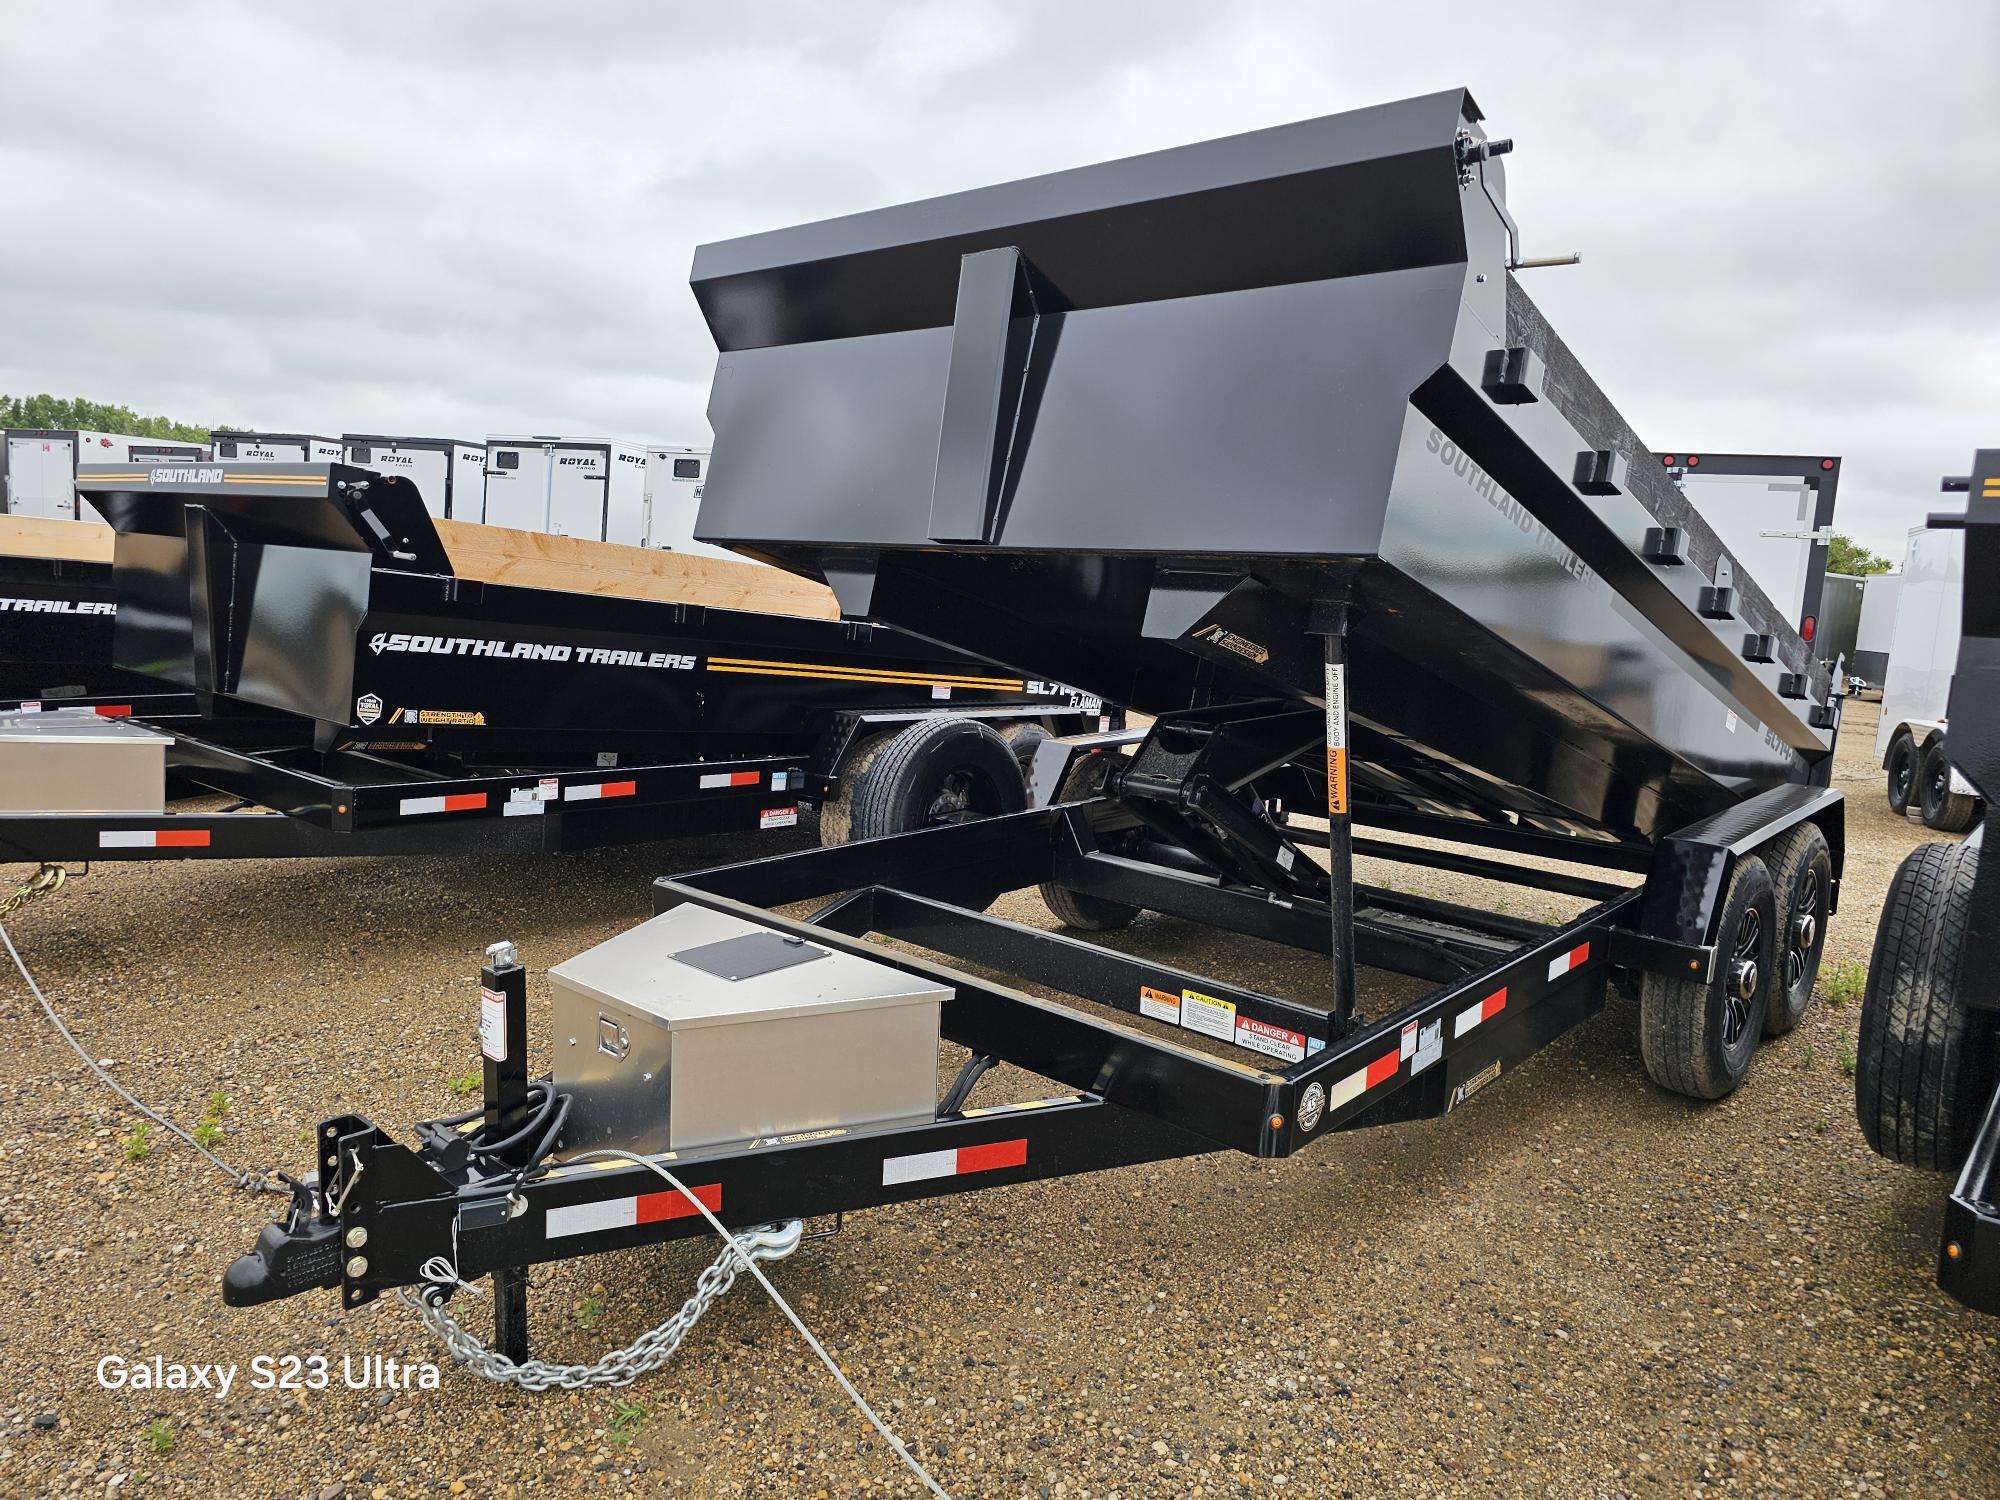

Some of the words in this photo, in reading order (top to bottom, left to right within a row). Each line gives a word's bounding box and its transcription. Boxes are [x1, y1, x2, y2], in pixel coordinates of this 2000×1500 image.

[246, 450, 275, 458] ROYAL
[380, 455, 413, 464] ROYAL
[559, 457, 596, 466] ROYAL
[155, 468, 223, 484] SOUTHLAND
[1426, 427, 1534, 534] SOUTHLAND
[388, 634, 572, 662] SOUTHLAND
[576, 647, 697, 670] TRAILERS
[1069, 696, 1103, 709] FLAMAN
[1329, 750, 1338, 799] WARNING
[1195, 995, 1222, 1008] CAUTION
[1251, 1022, 1288, 1040] DANGER
[1241, 1037, 1260, 1048] WHILE
[1261, 1044, 1297, 1060] OPERATING
[1248, 1033, 1269, 1044] STAND
[1270, 1039, 1291, 1050] CLEAR
